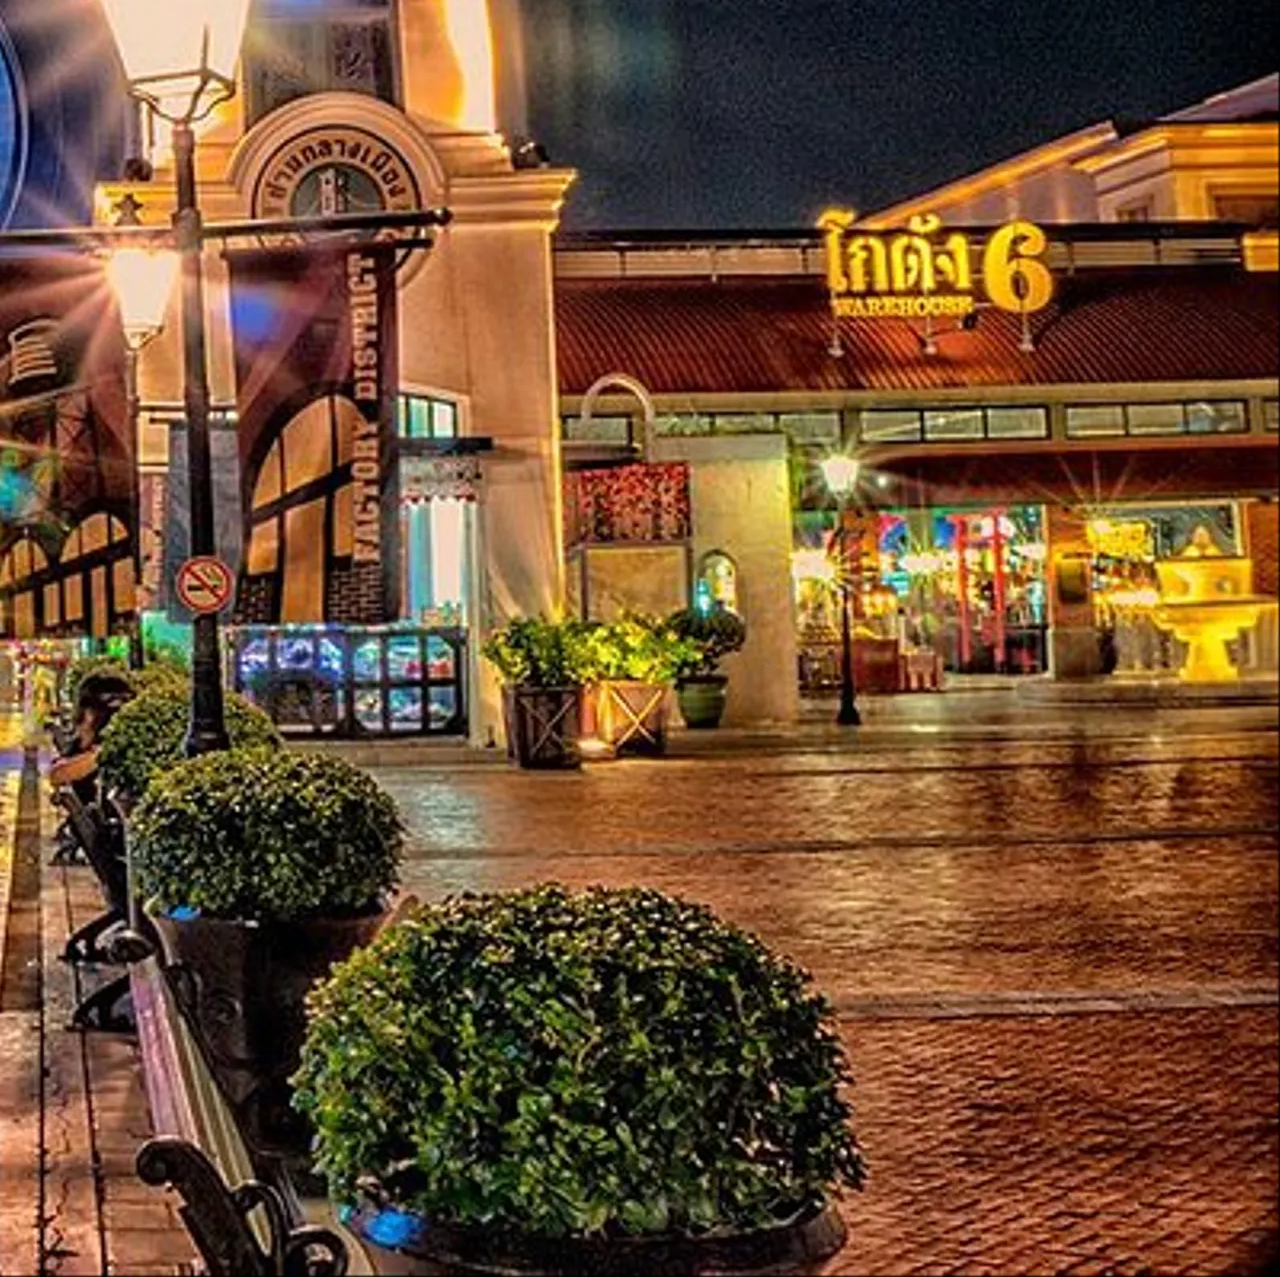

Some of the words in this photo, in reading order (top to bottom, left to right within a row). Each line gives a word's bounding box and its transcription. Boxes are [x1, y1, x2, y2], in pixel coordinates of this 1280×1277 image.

[817, 207, 973, 294] โกดัง
[983, 221, 1053, 314] 6
[832, 295, 974, 318] WAREHOUSE
[347, 253, 379, 401] DISTRICT
[351, 421, 381, 563] FACTORY
